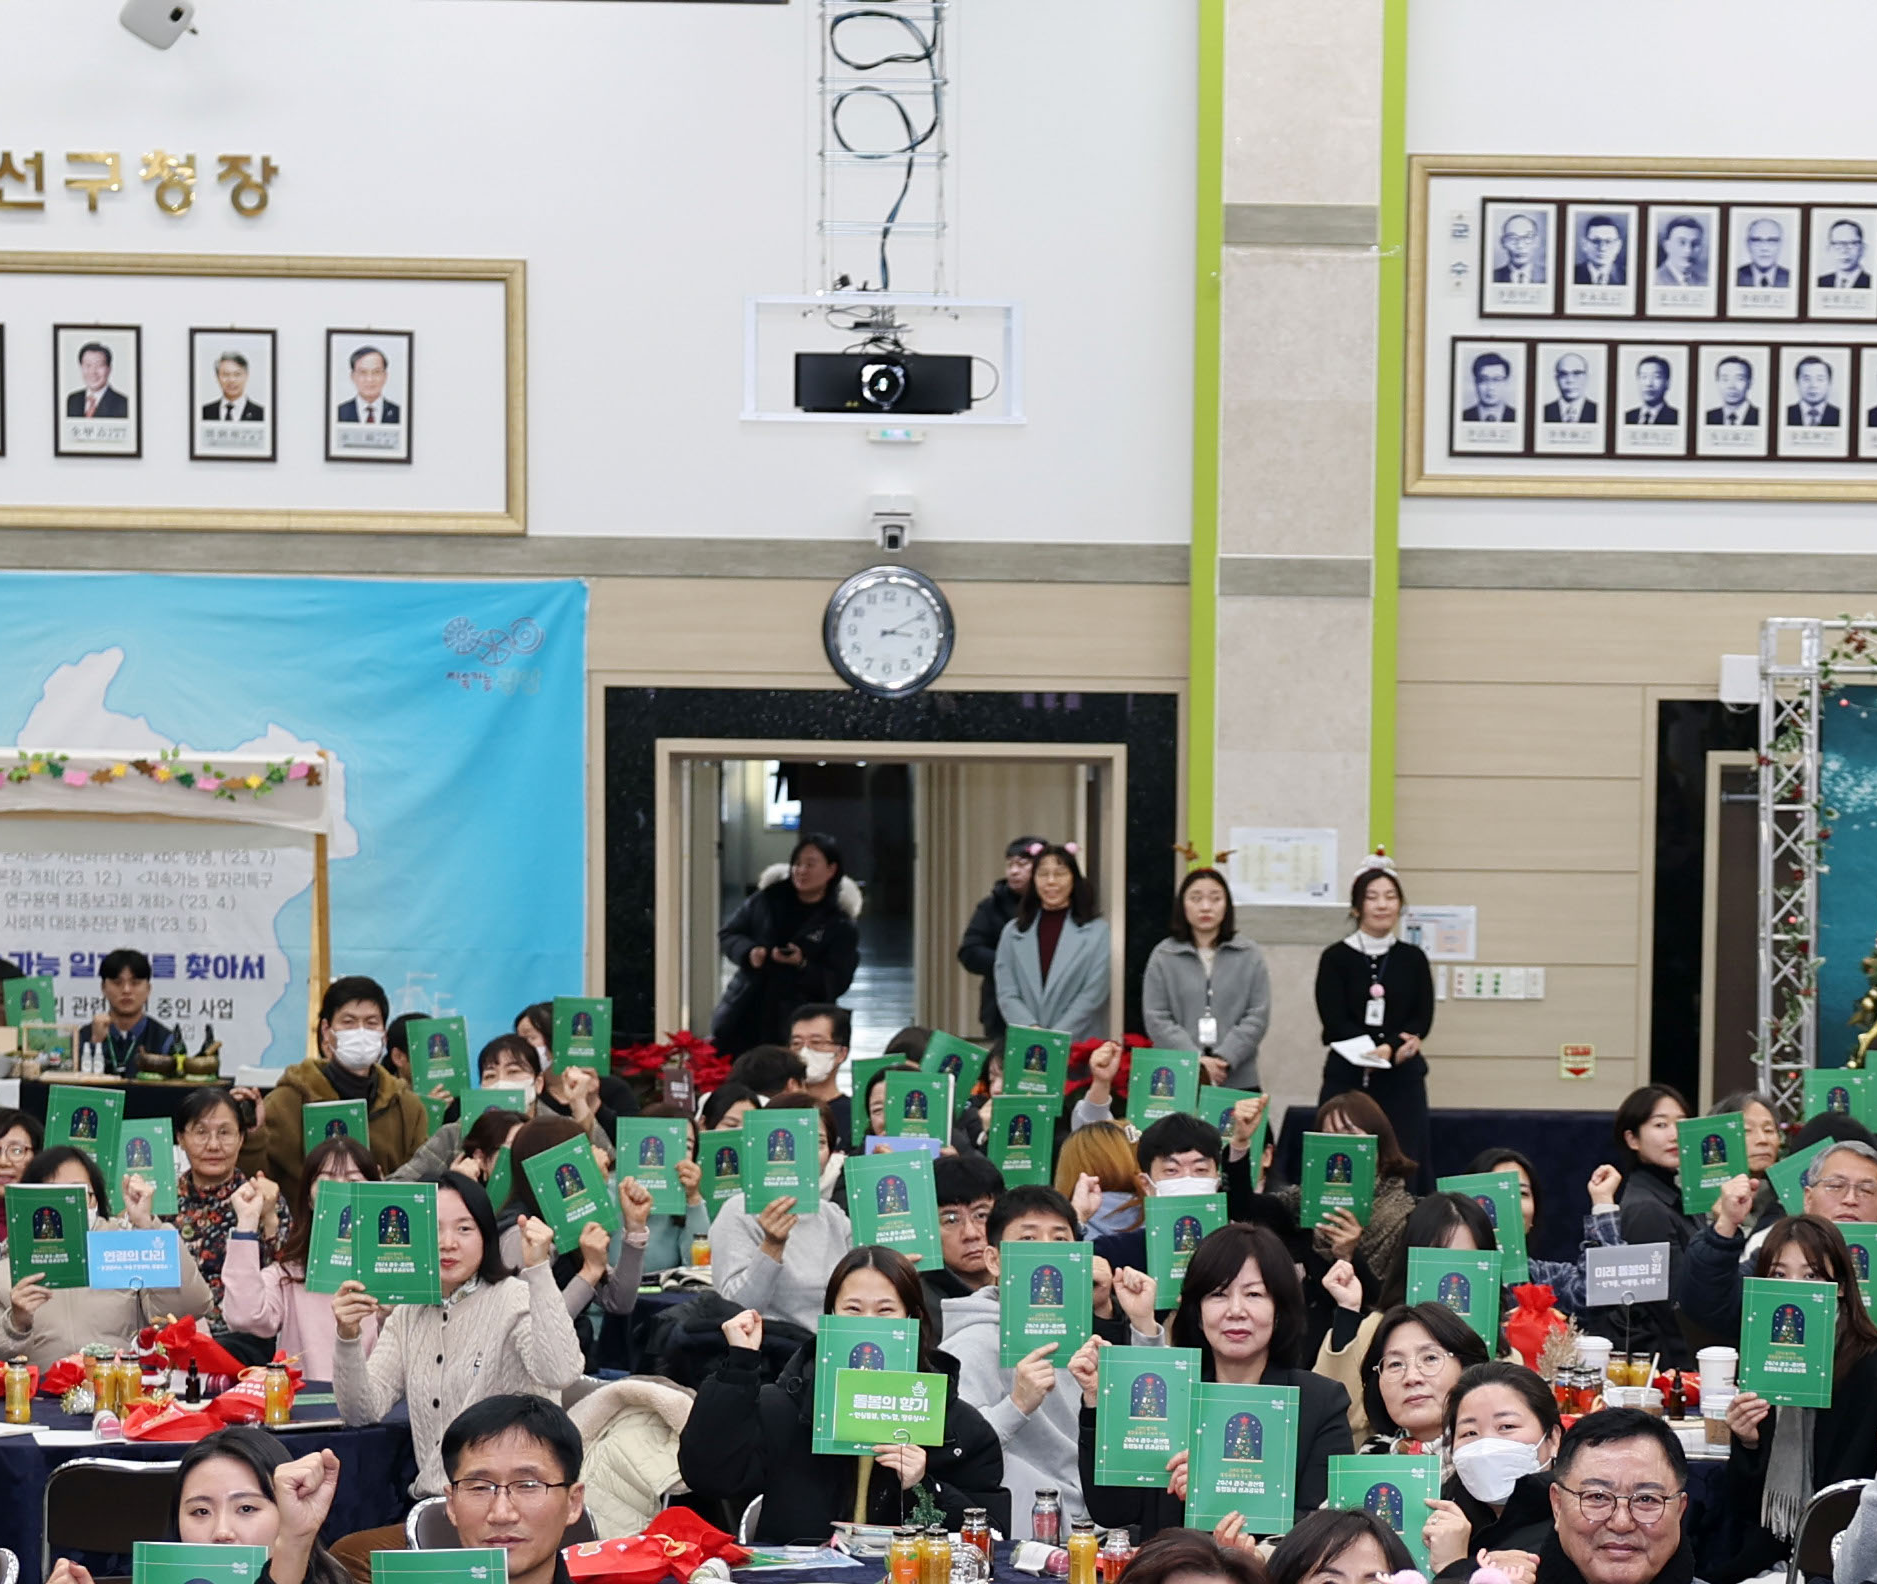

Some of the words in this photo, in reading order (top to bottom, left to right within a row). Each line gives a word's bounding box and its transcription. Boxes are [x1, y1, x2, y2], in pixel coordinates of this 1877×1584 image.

[185, 952, 265, 980] 찾아서
[198, 998, 233, 1019] 사업
[142, 1249, 165, 1262] 다리
[1595, 1266, 1616, 1278] 미래
[1651, 1263, 1662, 1274] 길
[853, 1394, 897, 1411] 돌봄의
[899, 1397, 929, 1412] 향기
